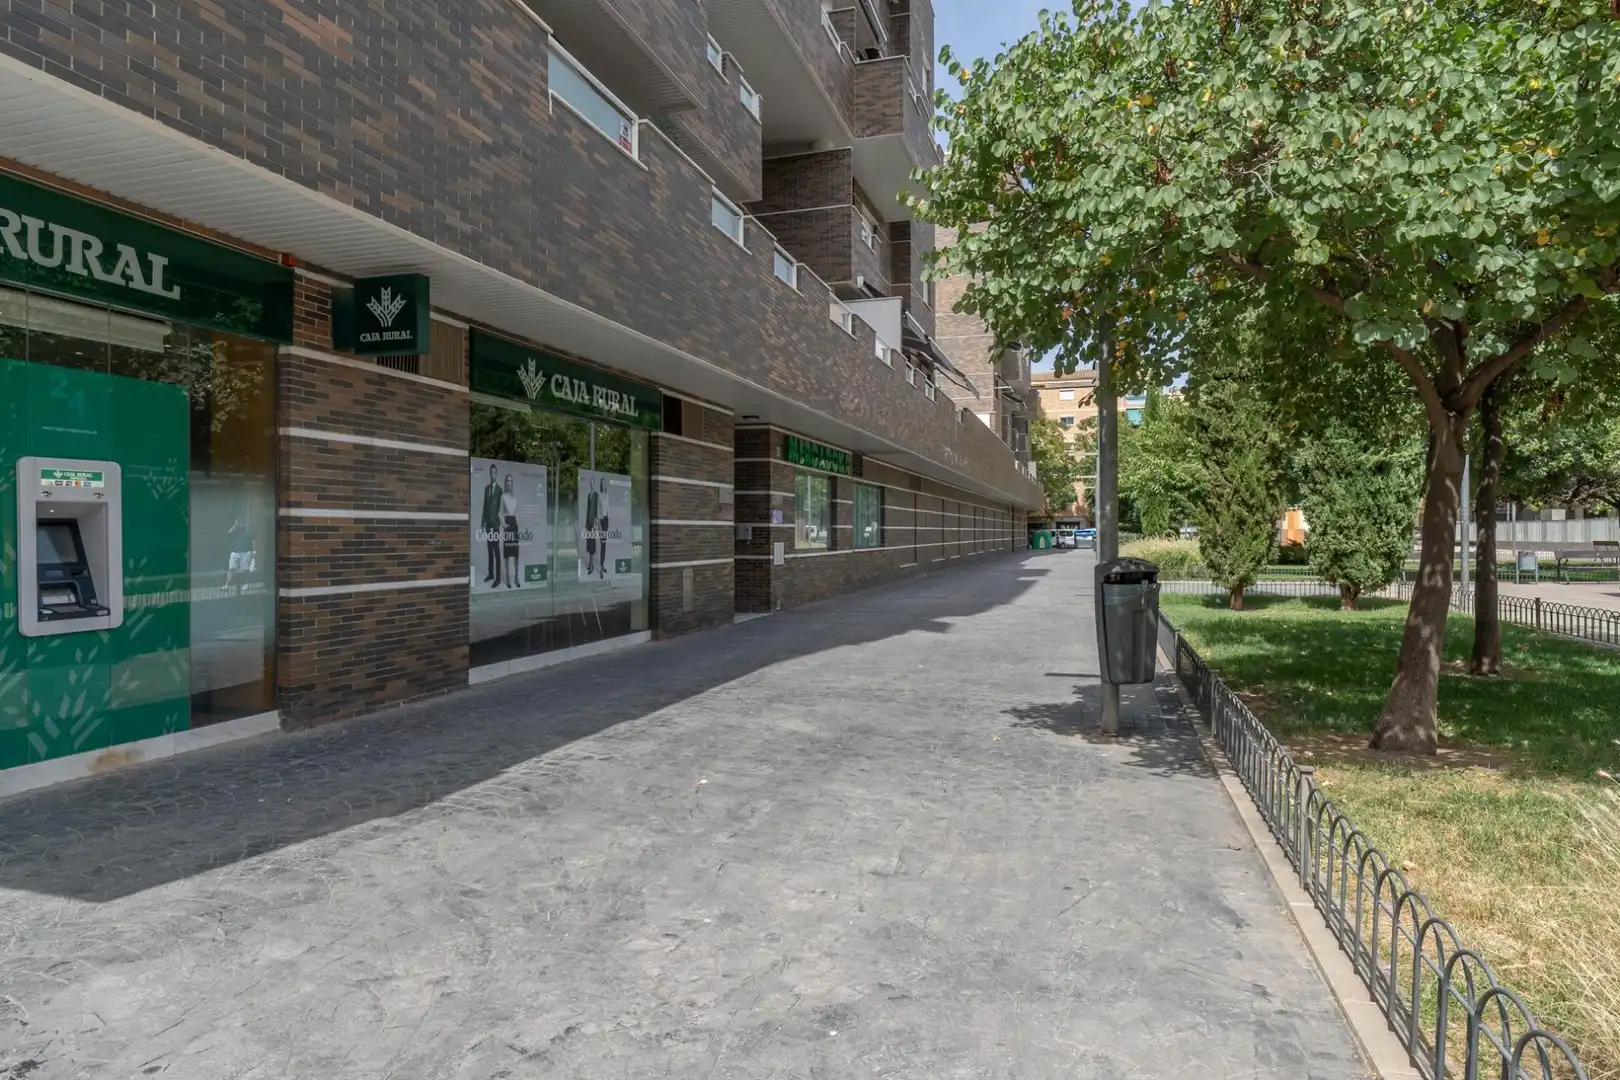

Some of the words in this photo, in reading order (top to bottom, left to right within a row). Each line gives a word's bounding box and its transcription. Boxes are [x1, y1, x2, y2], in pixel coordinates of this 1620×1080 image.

[0, 207, 181, 300] RURAL
[360, 332, 381, 342] CAJA
[382, 330, 413, 341] RURAL
[551, 373, 590, 404] CAJA
[592, 384, 639, 417] RURAL
[475, 527, 499, 542] Codo
